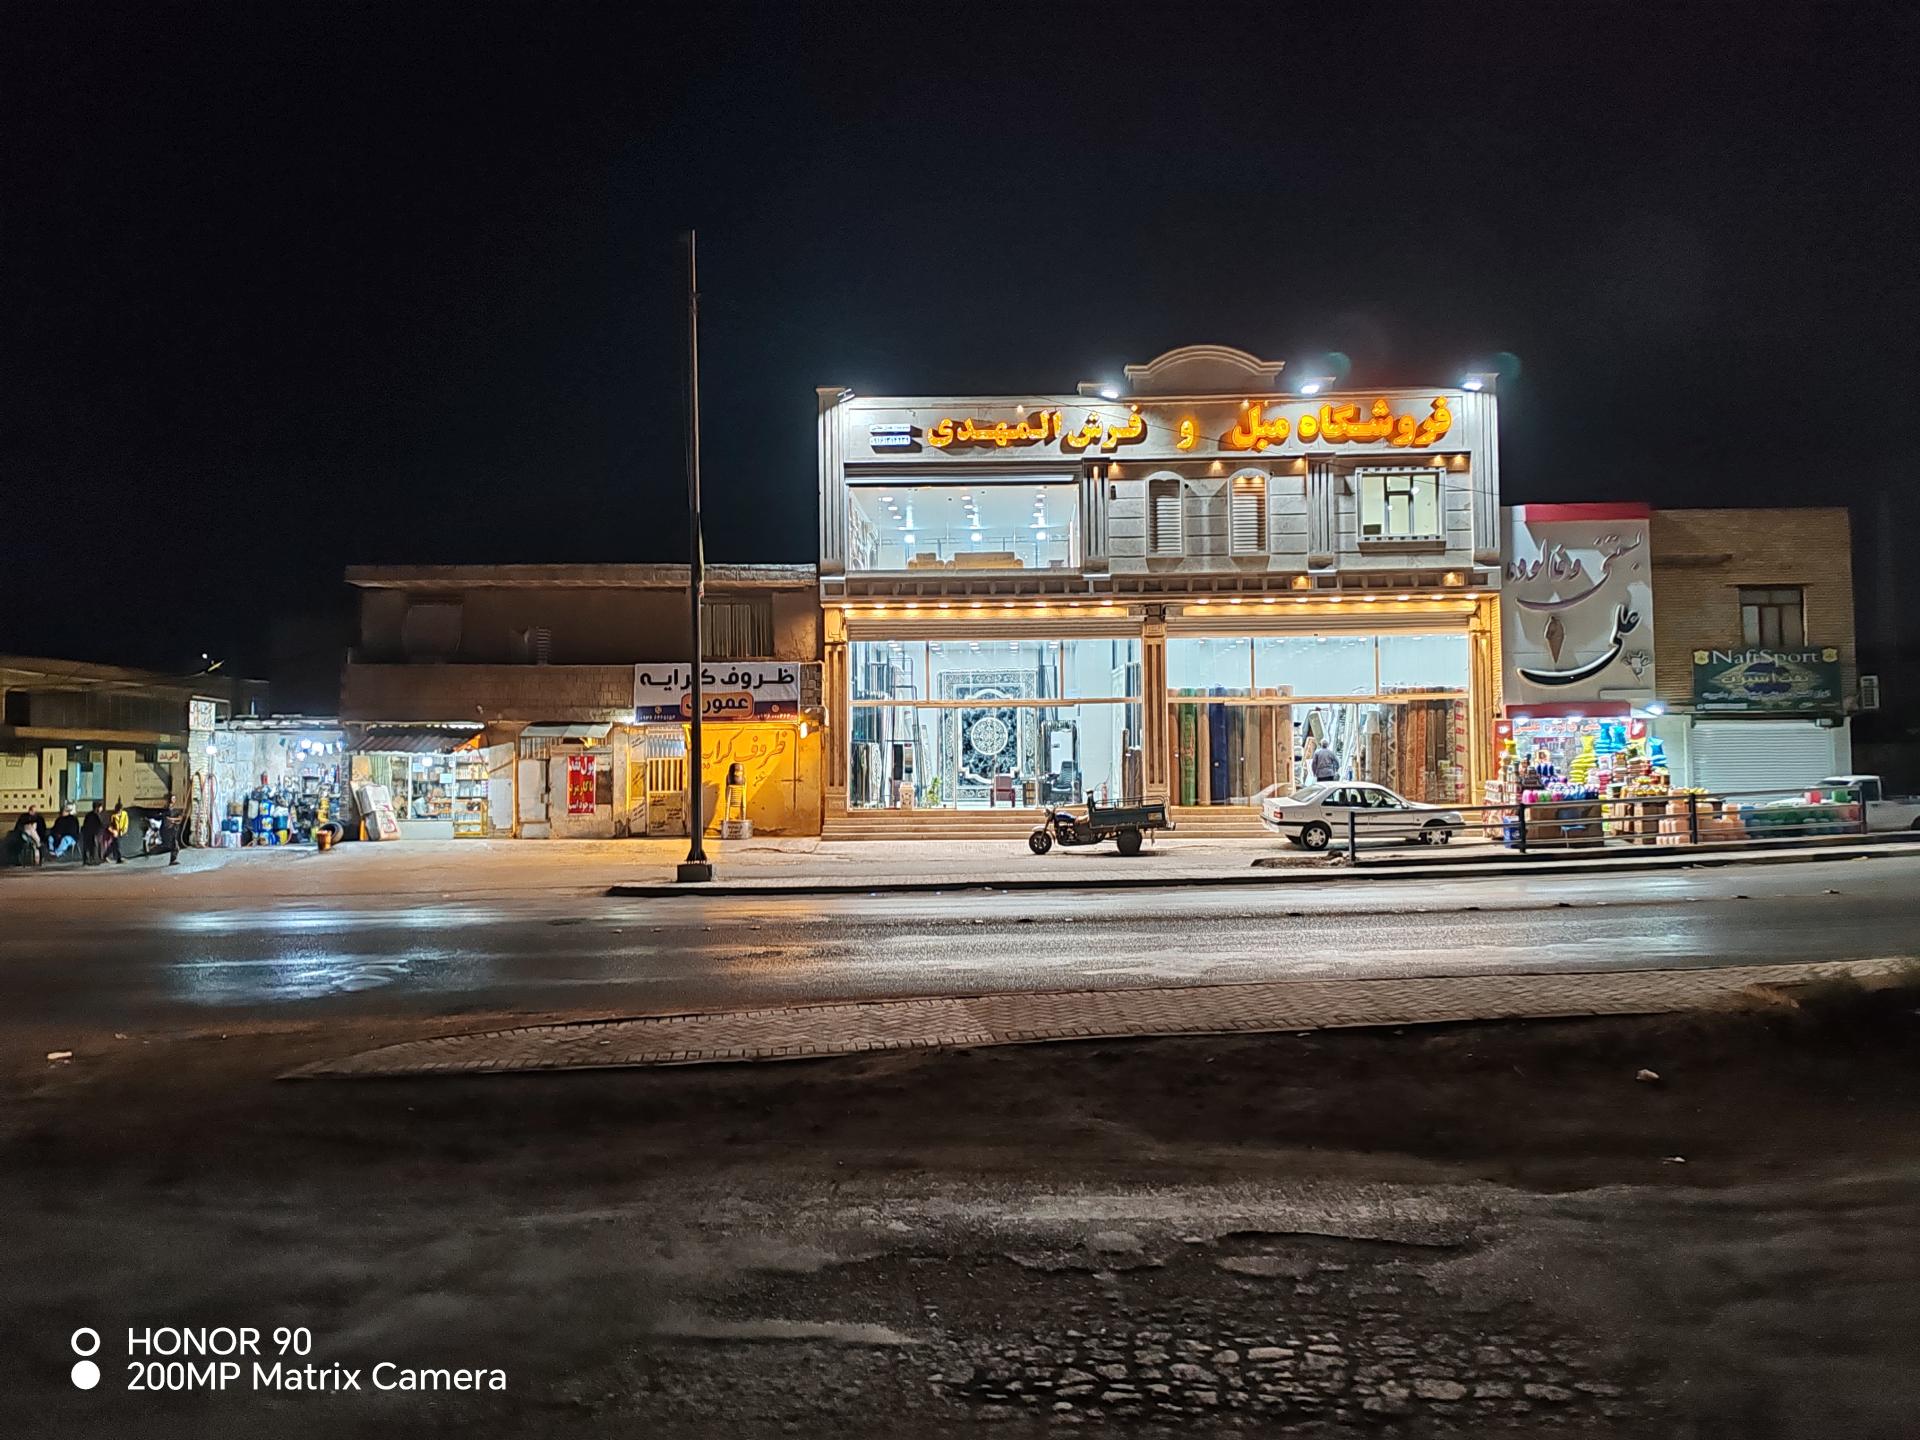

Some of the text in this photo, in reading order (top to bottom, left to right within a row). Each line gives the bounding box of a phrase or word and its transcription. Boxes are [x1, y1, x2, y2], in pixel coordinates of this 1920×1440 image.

[926, 396, 1453, 450] فروشگاه مبل و فرش المهدی
[1515, 530, 1643, 613] بستنی
[1516, 603, 1642, 689] علی
[639, 667, 795, 691] ظروف کرایه
[733, 730, 787, 769] ظروف
